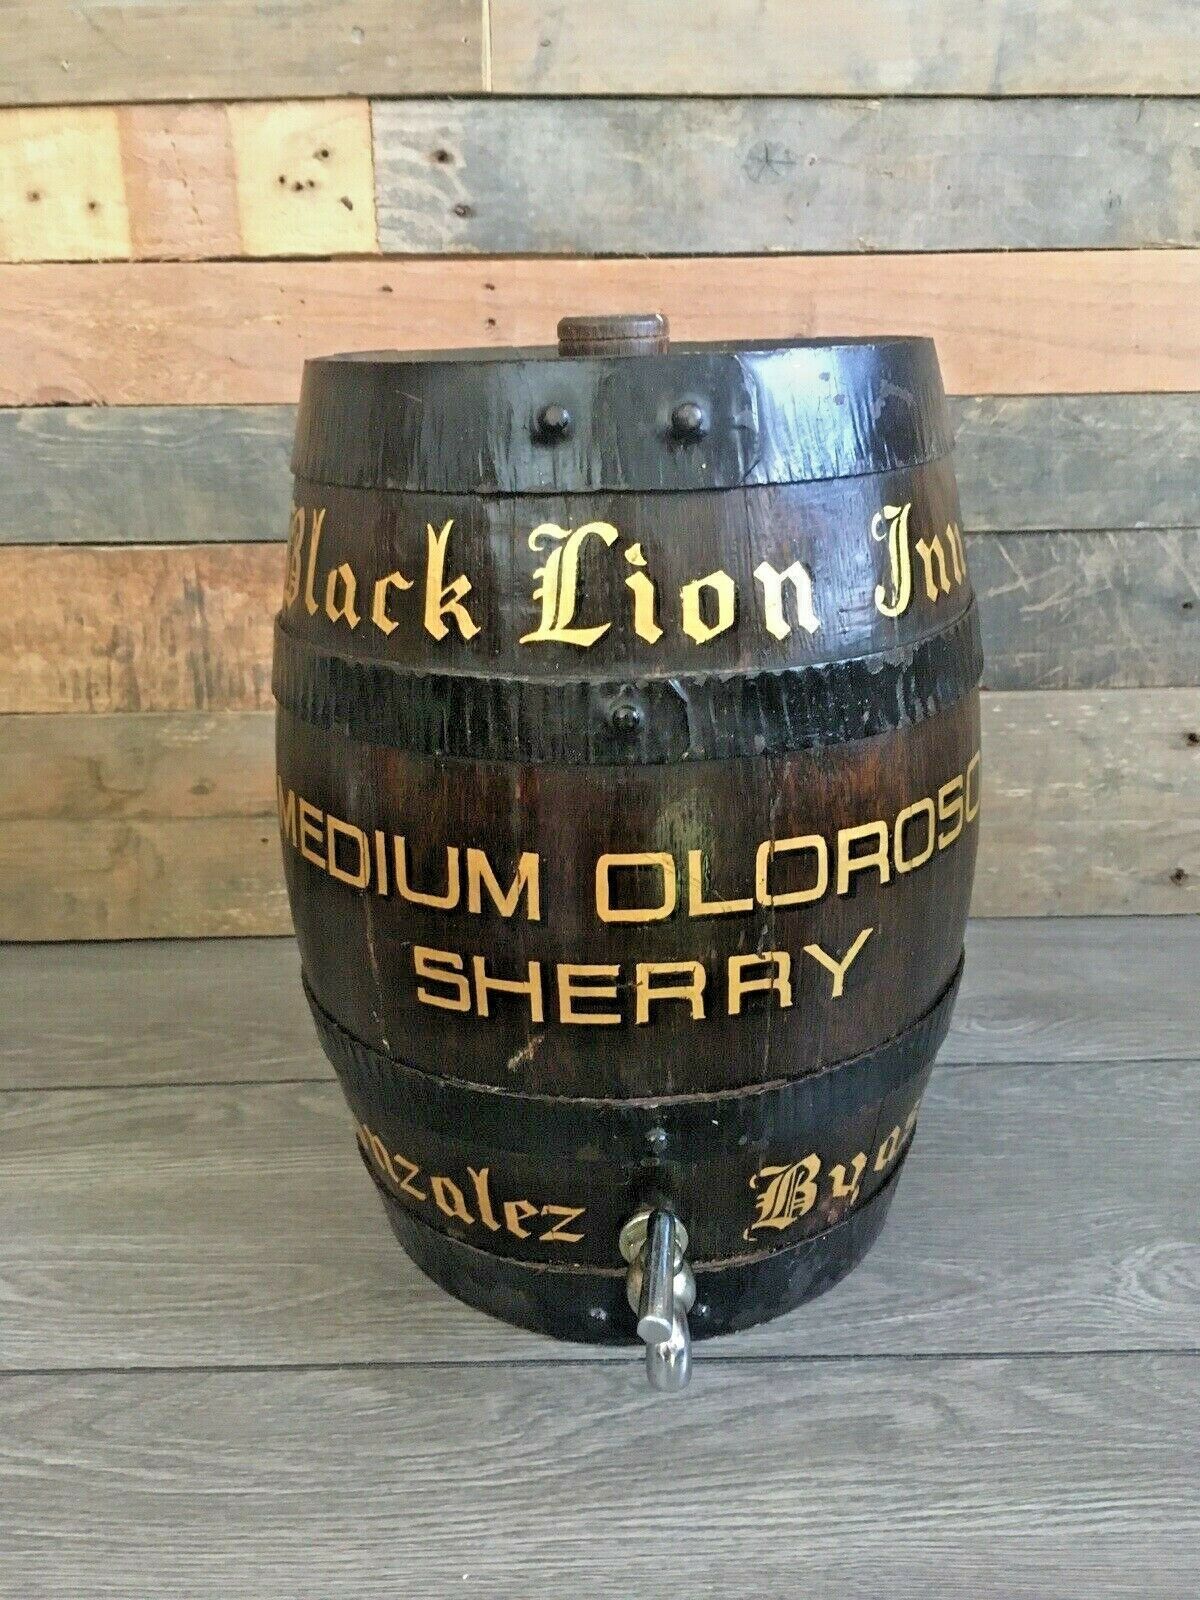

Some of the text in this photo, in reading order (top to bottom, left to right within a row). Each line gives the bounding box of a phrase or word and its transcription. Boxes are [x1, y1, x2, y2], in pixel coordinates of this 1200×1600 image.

[518, 521, 821, 646] Lion
[277, 775, 541, 921] MEDIUM
[413, 928, 874, 1024] SHERRY
